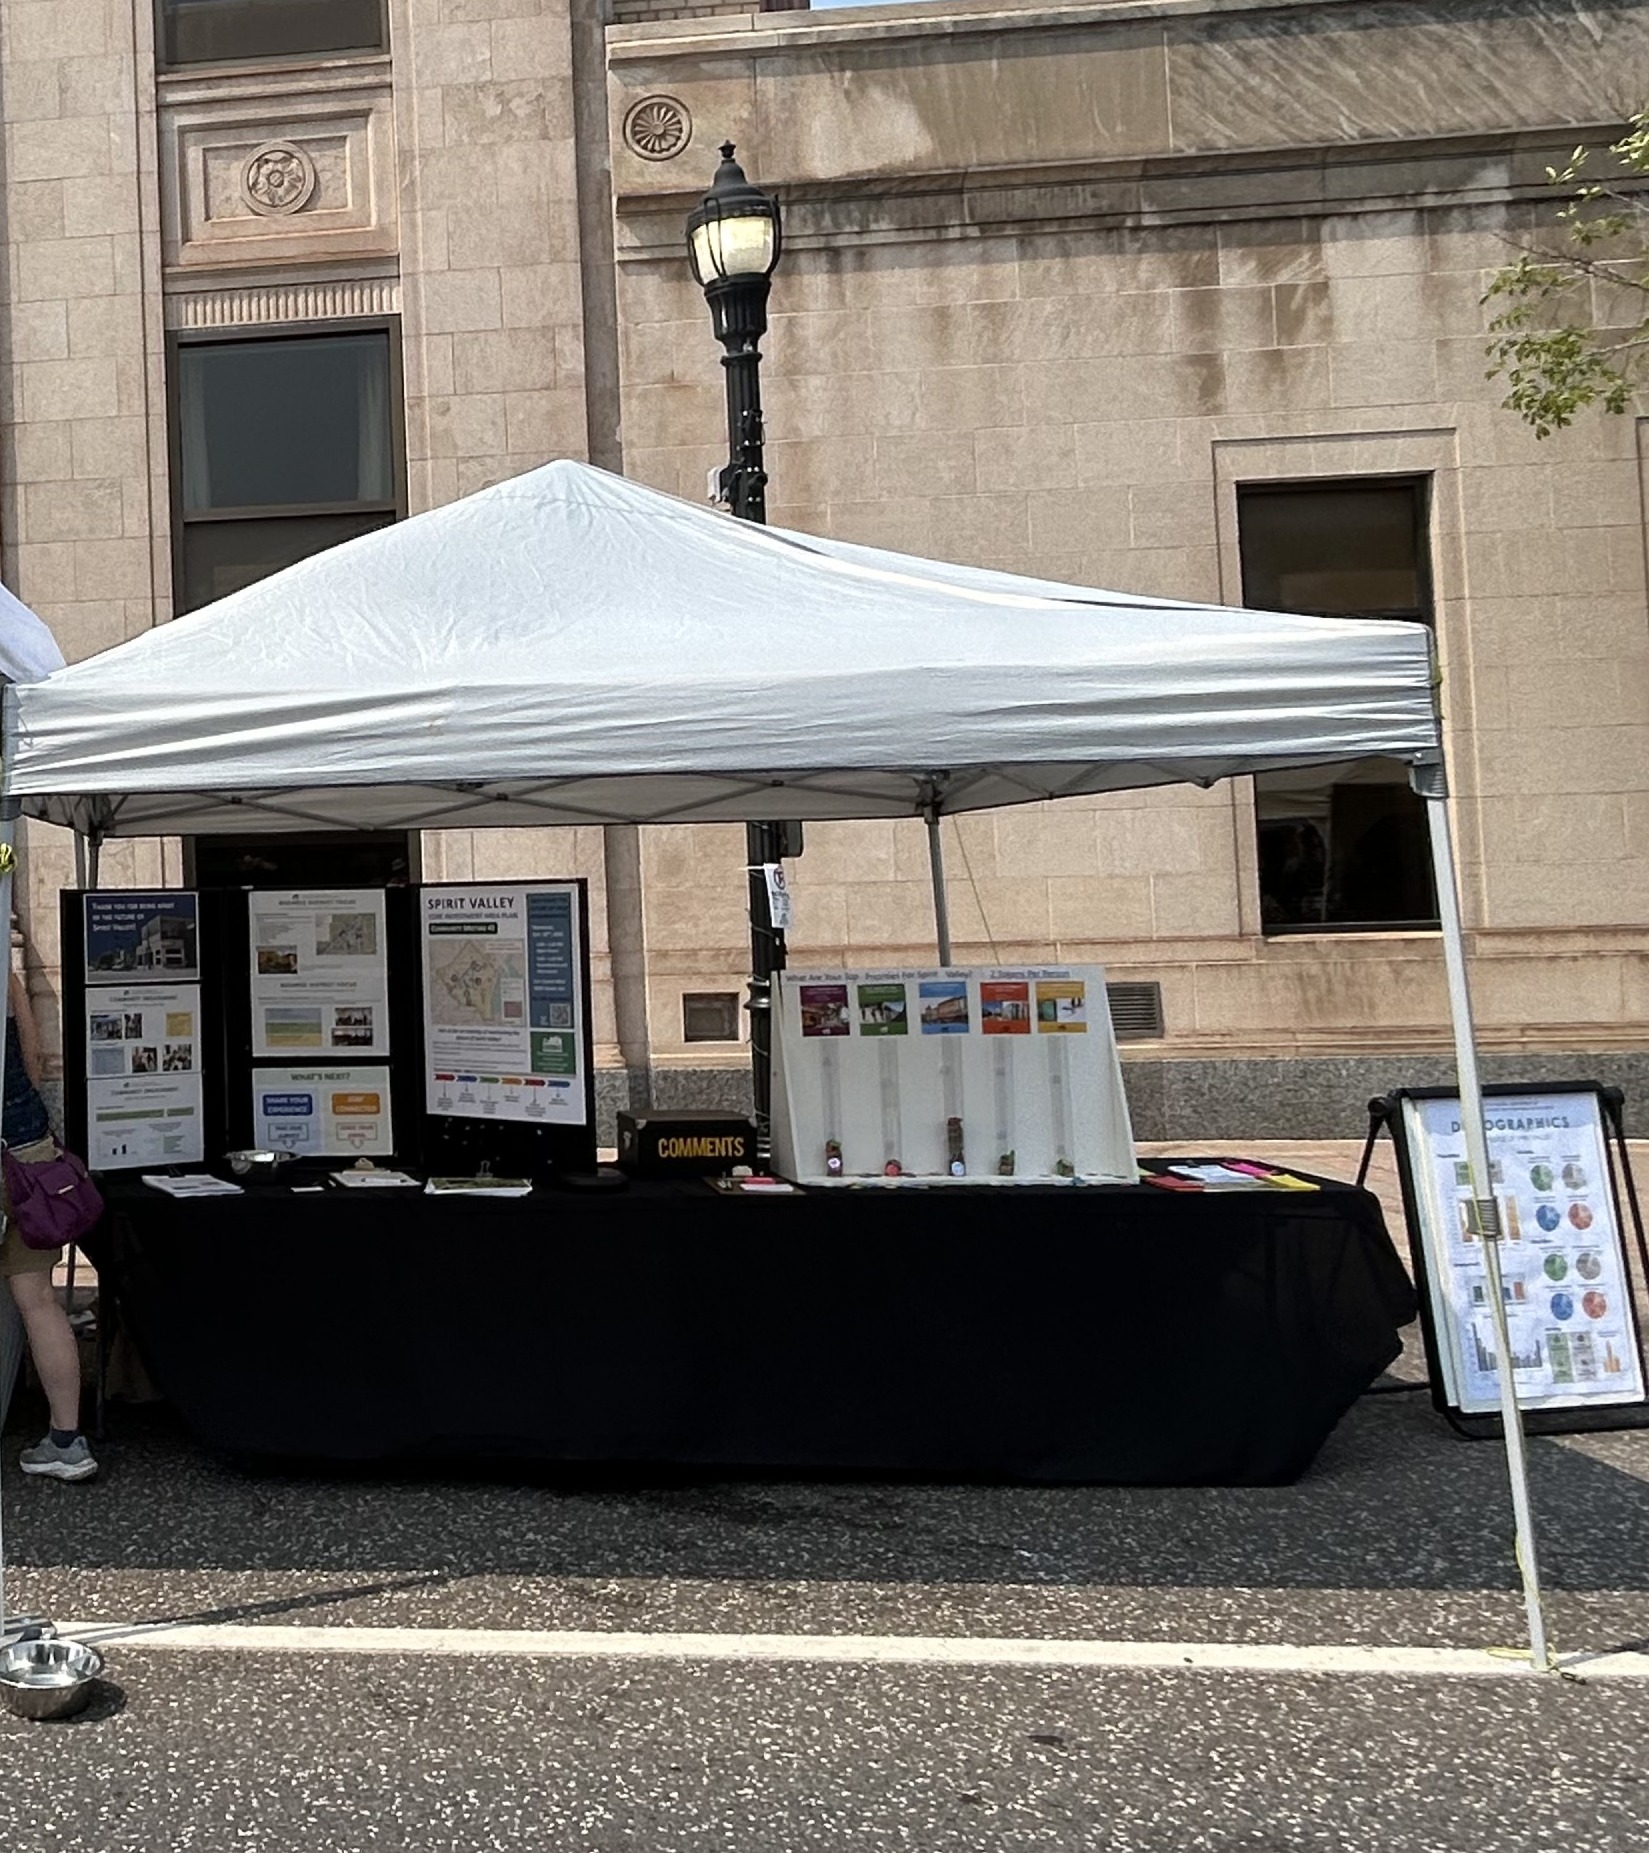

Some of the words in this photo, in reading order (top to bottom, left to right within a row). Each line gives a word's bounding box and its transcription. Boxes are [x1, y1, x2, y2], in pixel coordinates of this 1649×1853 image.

[428, 898, 465, 910] SPIRIT
[469, 897, 514, 909] VALLEY
[291, 1073, 323, 1081] WHAT'S
[324, 1073, 351, 1081] NEXT?
[1451, 1117, 1570, 1133] DOGRAPHICS
[658, 1136, 745, 1158] COMMENTS
